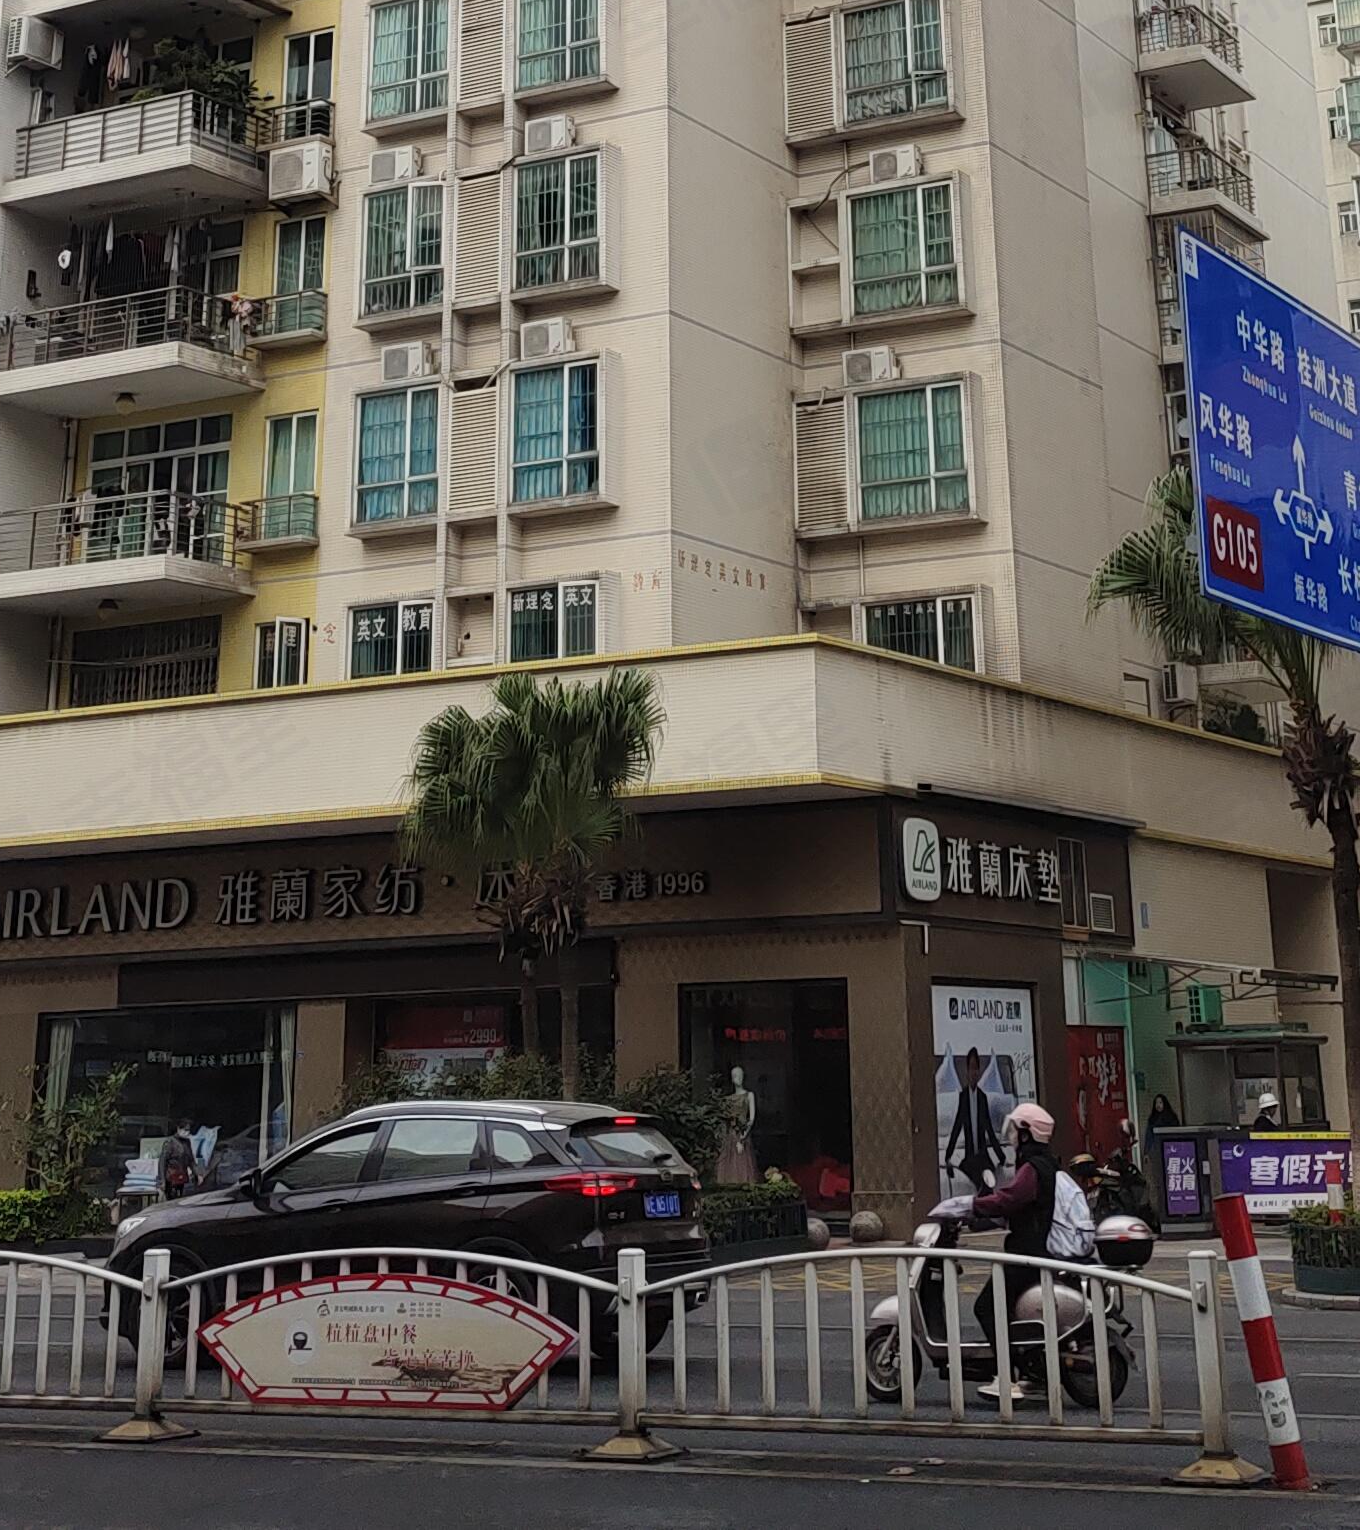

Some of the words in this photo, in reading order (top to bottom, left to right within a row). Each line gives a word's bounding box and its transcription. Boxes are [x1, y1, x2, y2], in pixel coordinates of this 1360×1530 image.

[1236, 309, 1285, 374] 中华路
[1296, 346, 1358, 416] 桂洲大道
[1278, 385, 1287, 404] Lu
[1199, 392, 1252, 459] 风华路
[1241, 468, 1251, 488] Lu
[1213, 513, 1257, 574] G105
[512, 590, 554, 613] 新理念
[564, 585, 593, 608] 英文
[1294, 572, 1329, 613] 振华路
[357, 617, 386, 642] 英文
[402, 606, 432, 631] 教育
[911, 878, 937, 892] AIRLAND
[960, 999, 1004, 1019] AIRLAND
[1167, 1157, 1195, 1174] 星火
[1168, 1174, 1195, 1192] 教育
[326, 1323, 417, 1344] 粒粒盘中餐
